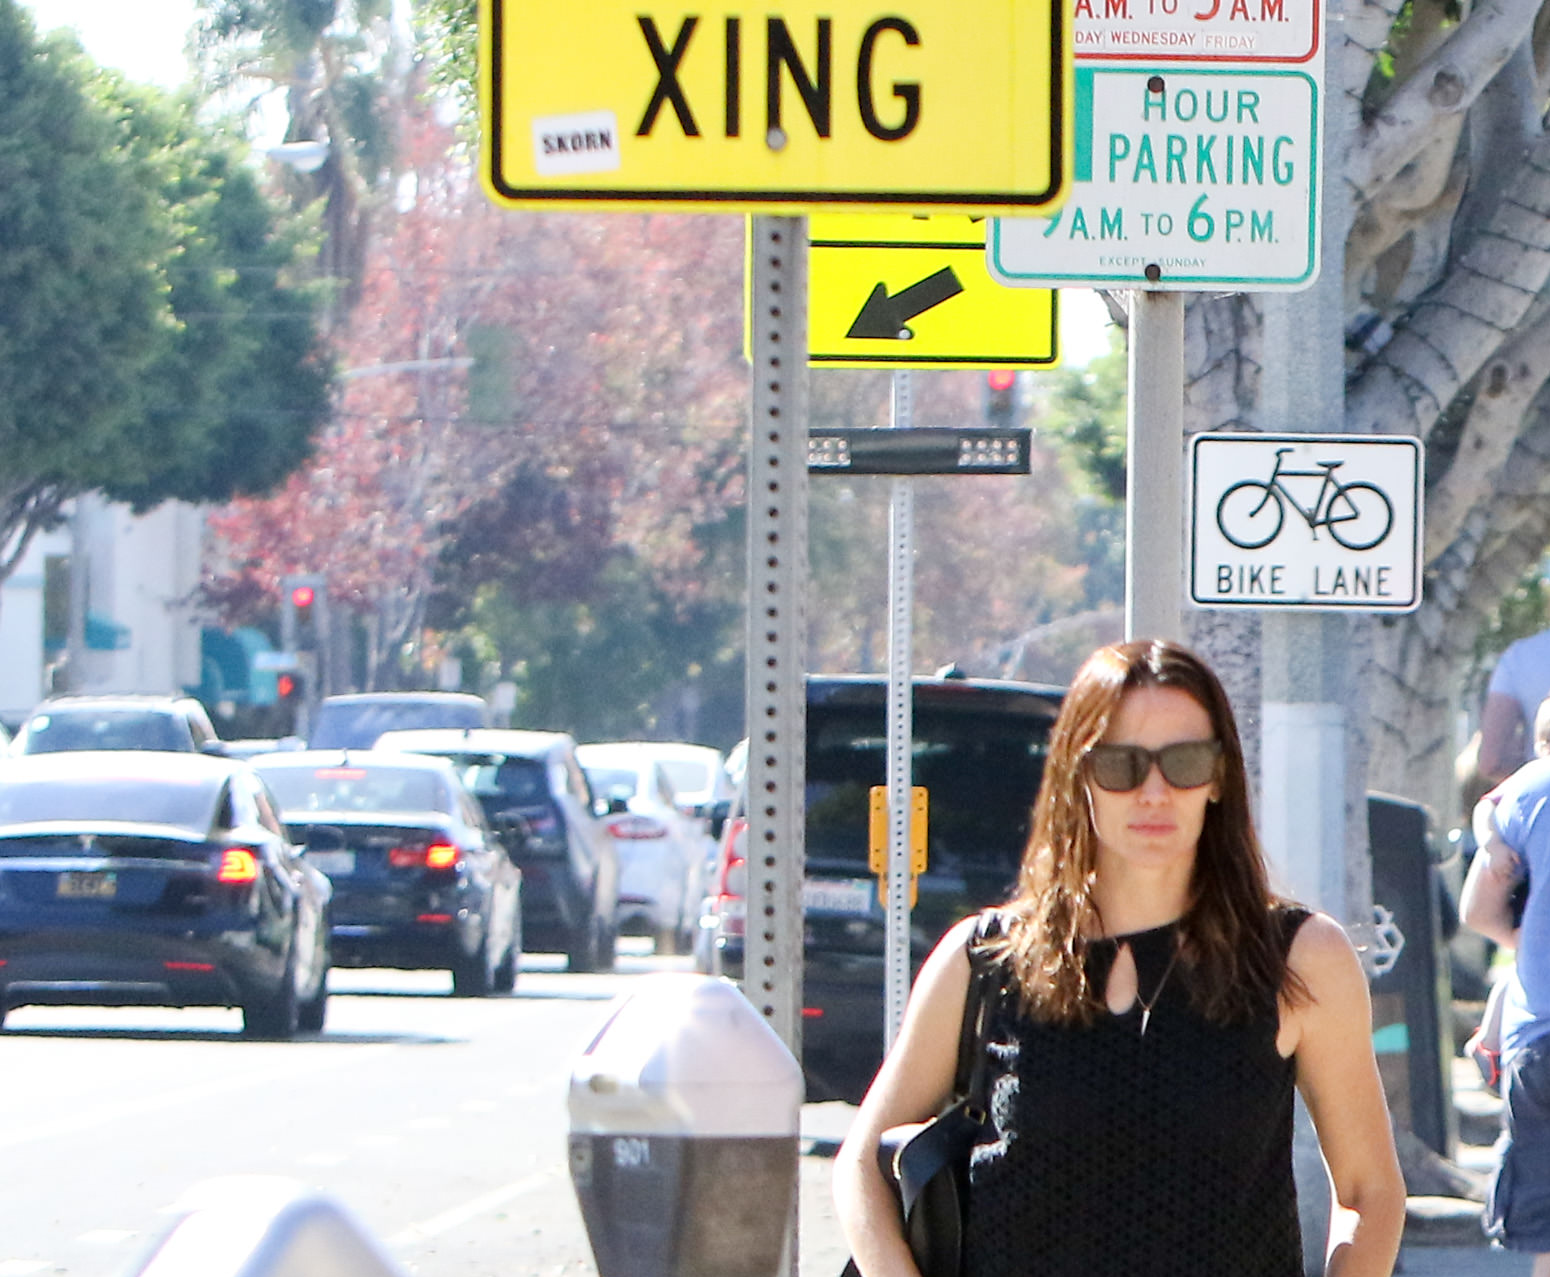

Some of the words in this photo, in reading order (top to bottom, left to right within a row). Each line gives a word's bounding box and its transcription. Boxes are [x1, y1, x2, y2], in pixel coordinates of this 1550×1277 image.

[1110, 31, 1197, 46] WEDNESDAY
[1205, 35, 1256, 49] FRIDAY
[635, 15, 922, 142] XING
[1143, 89, 1261, 123] HOUR
[1109, 133, 1294, 185] PARKING
[1068, 206, 1128, 240] A.M.
[1140, 213, 1173, 236] TO
[1187, 193, 1215, 242] 6
[1099, 256, 1147, 267] EXCEPT
[1158, 257, 1207, 268] SUNDAY
[1217, 564, 1286, 595] BIKE
[1314, 566, 1392, 597] LANE
